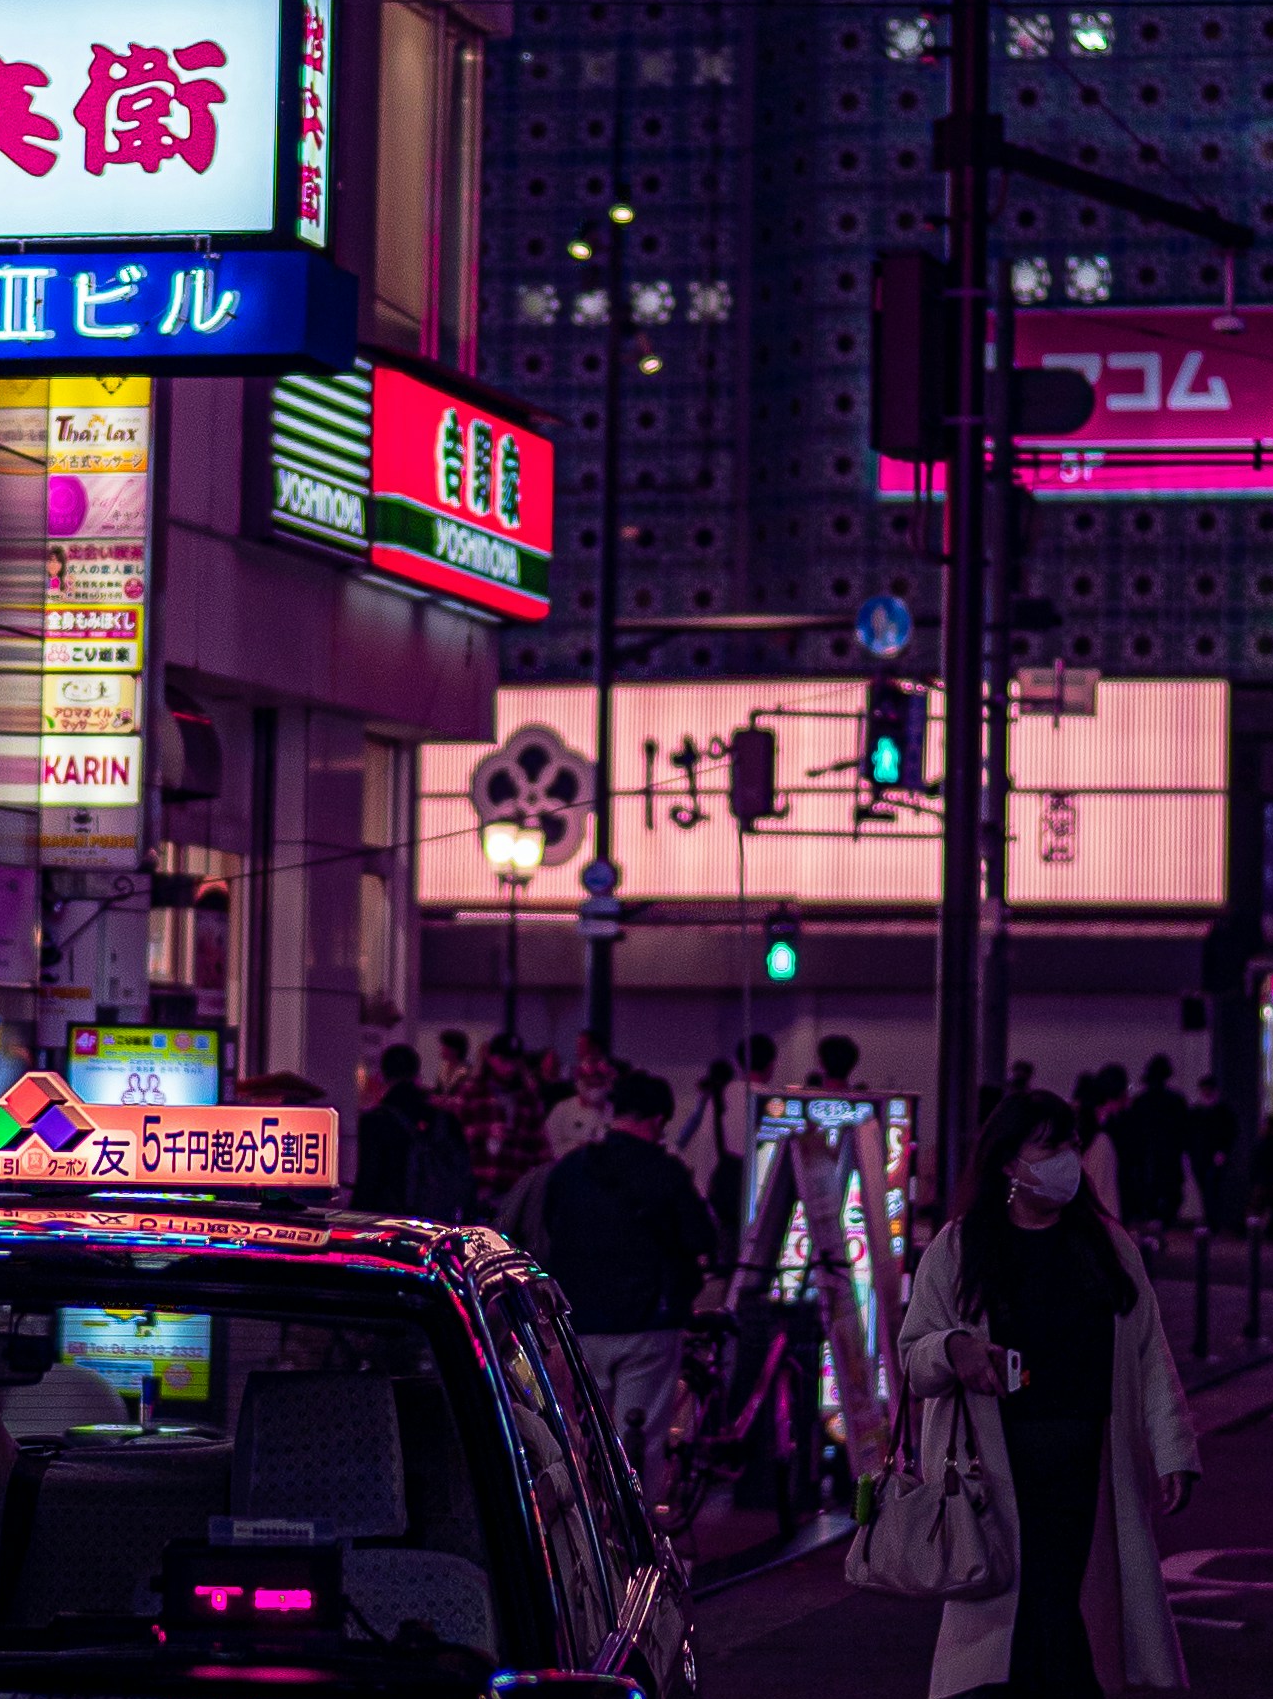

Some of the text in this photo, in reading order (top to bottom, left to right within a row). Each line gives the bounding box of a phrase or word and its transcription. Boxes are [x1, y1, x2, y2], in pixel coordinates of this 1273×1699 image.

[56, 414, 98, 442] Thai
[274, 468, 365, 536] YOSHINOYA
[434, 516, 519, 584] YOSHINOYA
[43, 755, 131, 786] KARIN
[92, 1136, 130, 1176] 友
[142, 1115, 328, 1177] 5千円超分5割引
[47, 1159, 87, 1176] クーポン
